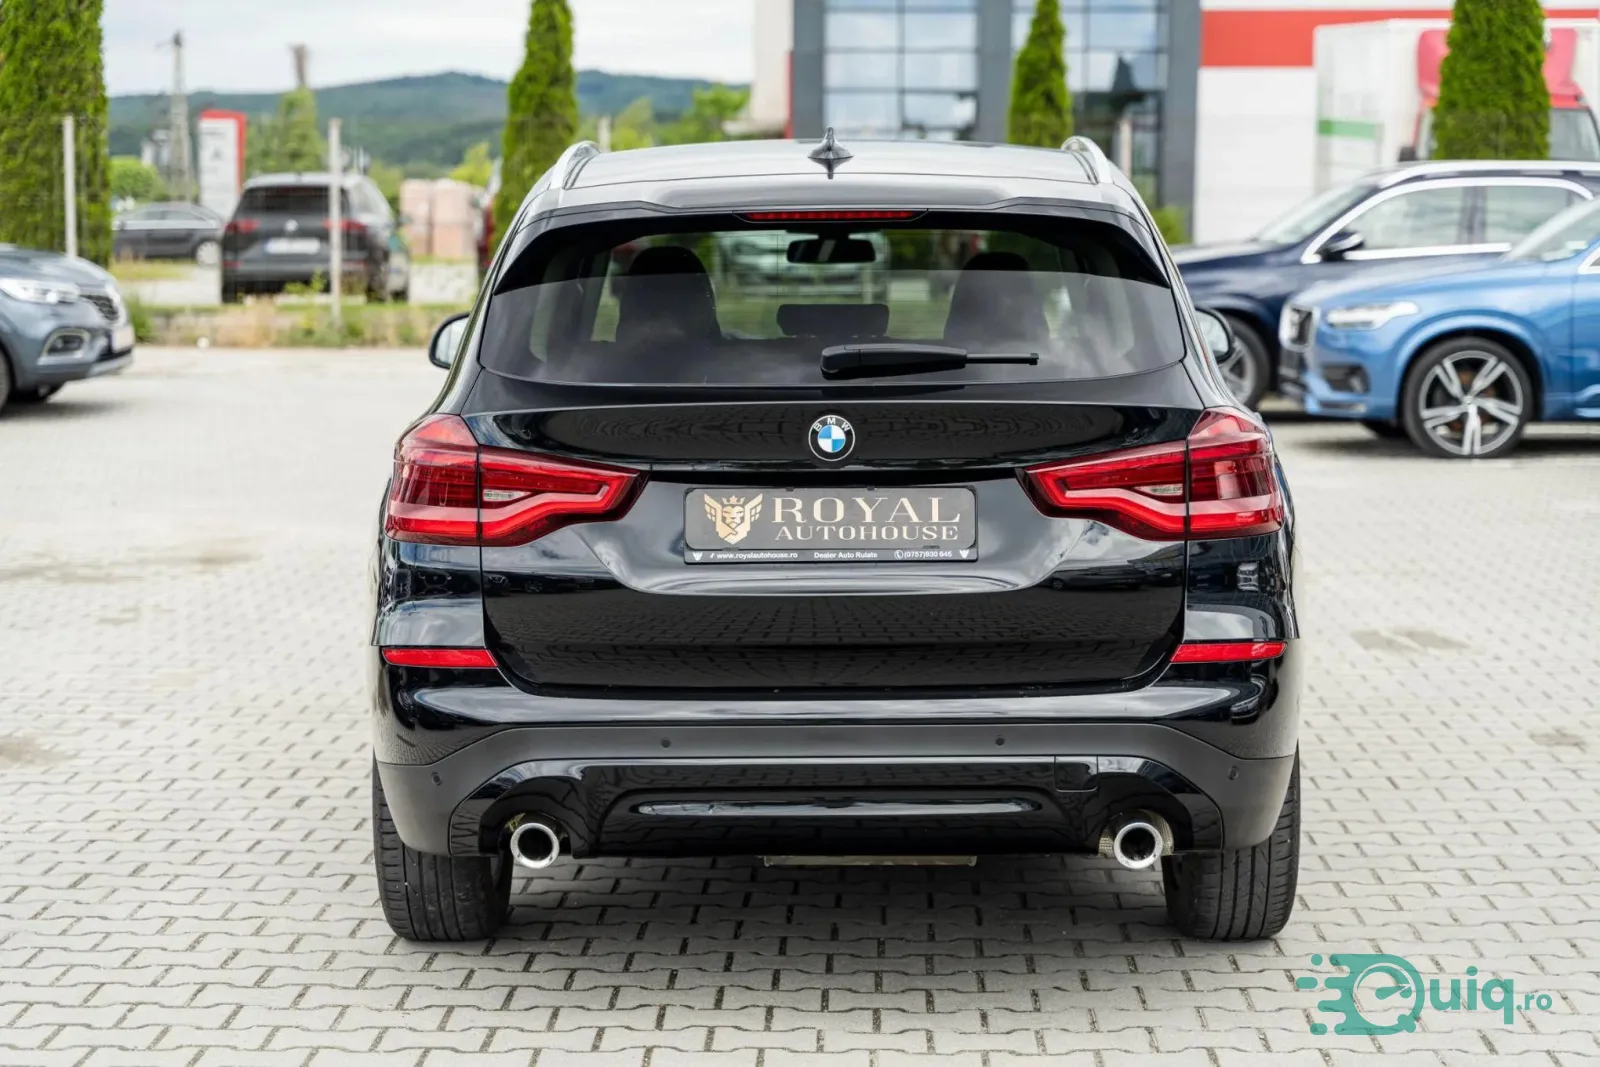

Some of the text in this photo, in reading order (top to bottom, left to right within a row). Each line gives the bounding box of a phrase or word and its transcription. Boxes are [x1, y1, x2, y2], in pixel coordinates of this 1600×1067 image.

[813, 417, 851, 432] BMW
[771, 497, 961, 523] ROYAL
[774, 525, 959, 541] AUTOHOUSE
[716, 551, 798, 560] www.royalautohouse.ro
[813, 550, 878, 559] Dealer Auto Rulate
